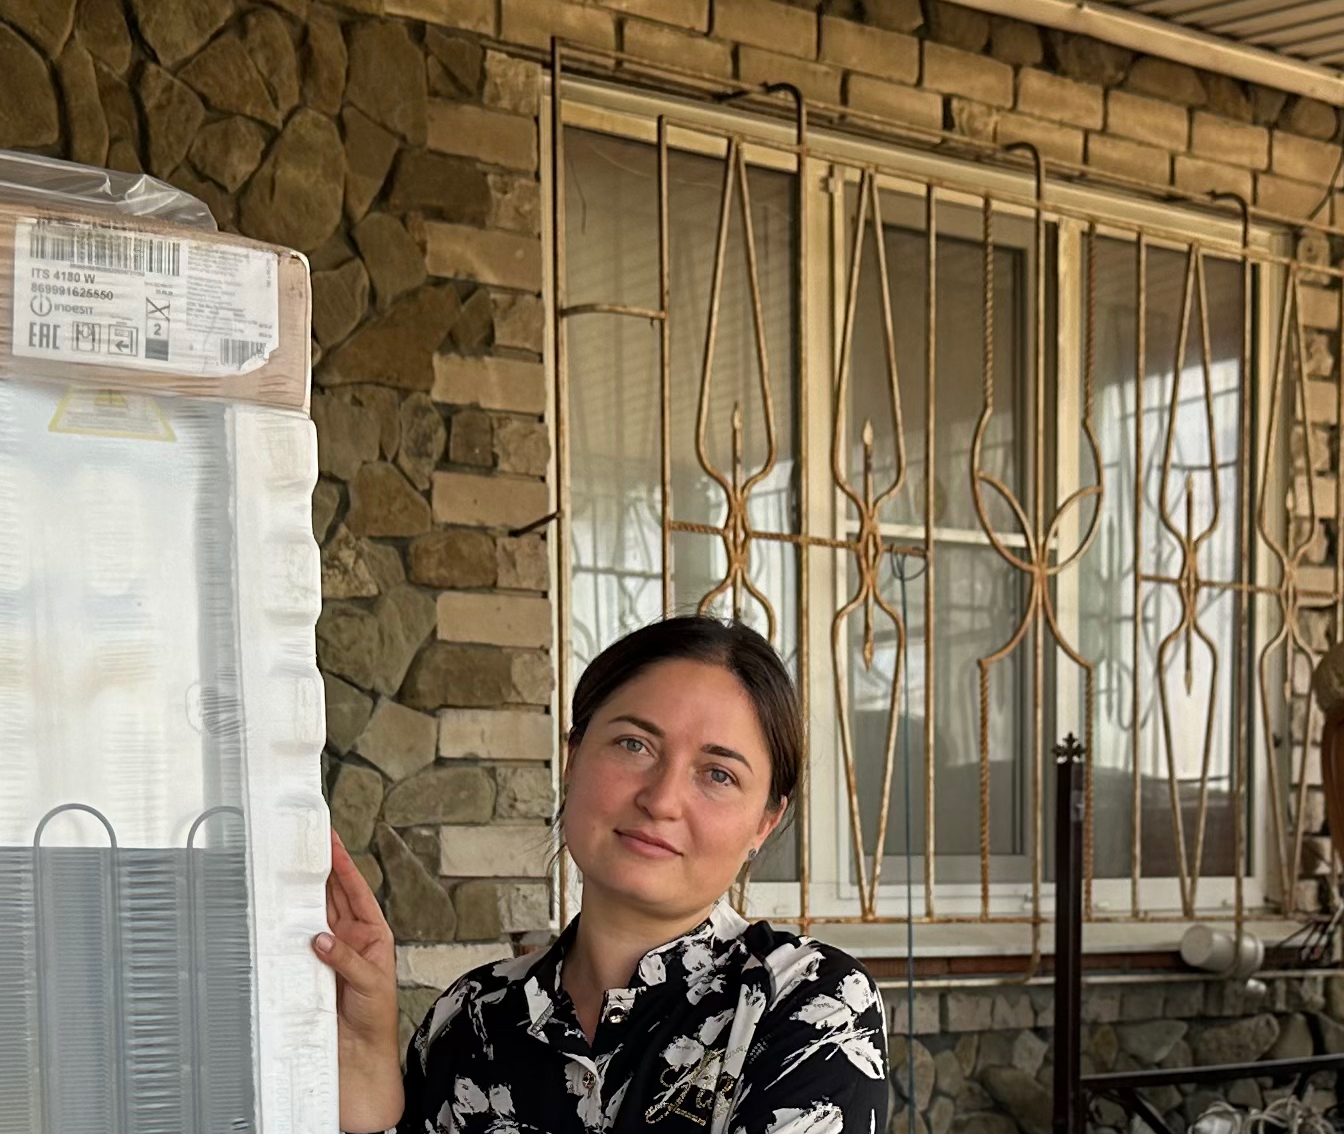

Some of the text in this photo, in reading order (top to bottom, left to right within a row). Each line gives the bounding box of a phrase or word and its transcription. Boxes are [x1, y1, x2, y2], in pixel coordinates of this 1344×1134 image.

[31, 267, 95, 284] ITS 4180 W
[153, 323, 162, 336] 2
